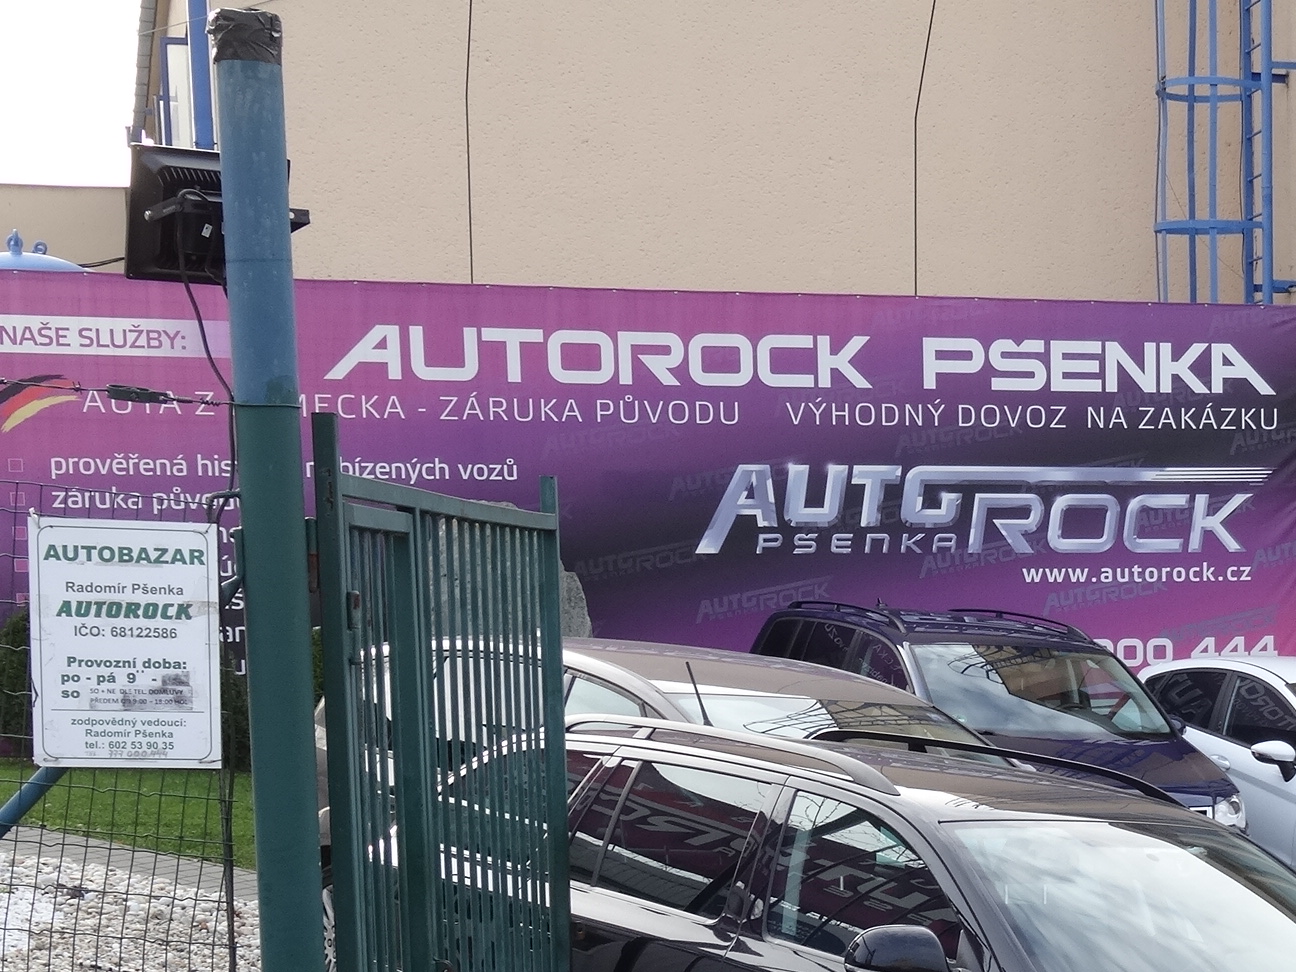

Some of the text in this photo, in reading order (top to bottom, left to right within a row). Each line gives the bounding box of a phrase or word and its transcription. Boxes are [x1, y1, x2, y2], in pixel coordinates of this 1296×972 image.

[0, 322, 188, 350] NAŠE SLUŽBY:
[324, 325, 871, 390] AUTOROCK
[439, 392, 583, 423] ZÁRUKA
[596, 394, 740, 426] PŮVODU
[786, 397, 946, 428] VÝHODNÝ
[957, 404, 1068, 430] DOVOZ
[1086, 406, 1129, 430] NA
[1138, 402, 1279, 431] ZAKÁZKU
[50, 453, 188, 479] prověřená
[458, 458, 518, 481] vozů
[51, 486, 143, 509] záruka
[694, 463, 1276, 555] AUTOROCK
[43, 544, 206, 566] AUTOBAZAR
[1022, 561, 1253, 583] www.autorock.cz
[65, 581, 184, 596] Radomír Pšenka
[56, 599, 193, 621] AUTOROCK
[73, 622, 178, 639] IČO: 68122586
[1190, 635, 1279, 658] 444
[66, 656, 187, 671] Provozní doba:
[60, 673, 81, 686] po
[96, 672, 117, 686] pá
[60, 689, 81, 699] so
[70, 716, 187, 729] zodpovědný vedoucí:
[85, 728, 174, 739] Radomír Pšenka
[85, 741, 175, 750] tel.: 602 53 90 35
